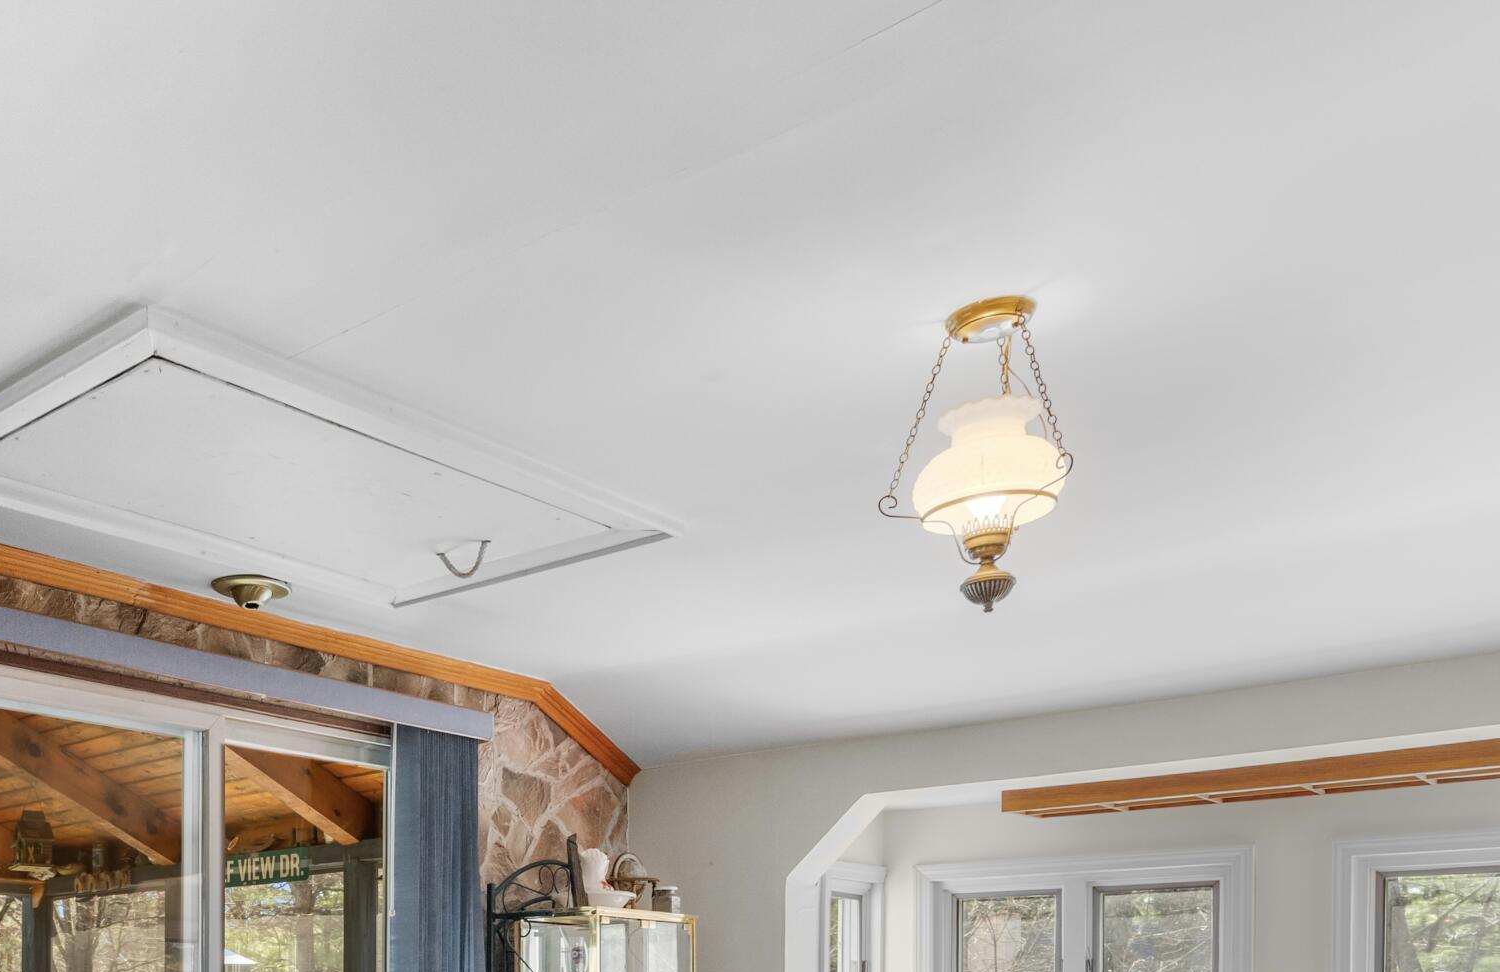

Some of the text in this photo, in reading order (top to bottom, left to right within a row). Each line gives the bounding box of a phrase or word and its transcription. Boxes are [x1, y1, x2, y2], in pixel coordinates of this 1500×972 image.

[225, 853, 304, 883] F VIEW DR.
